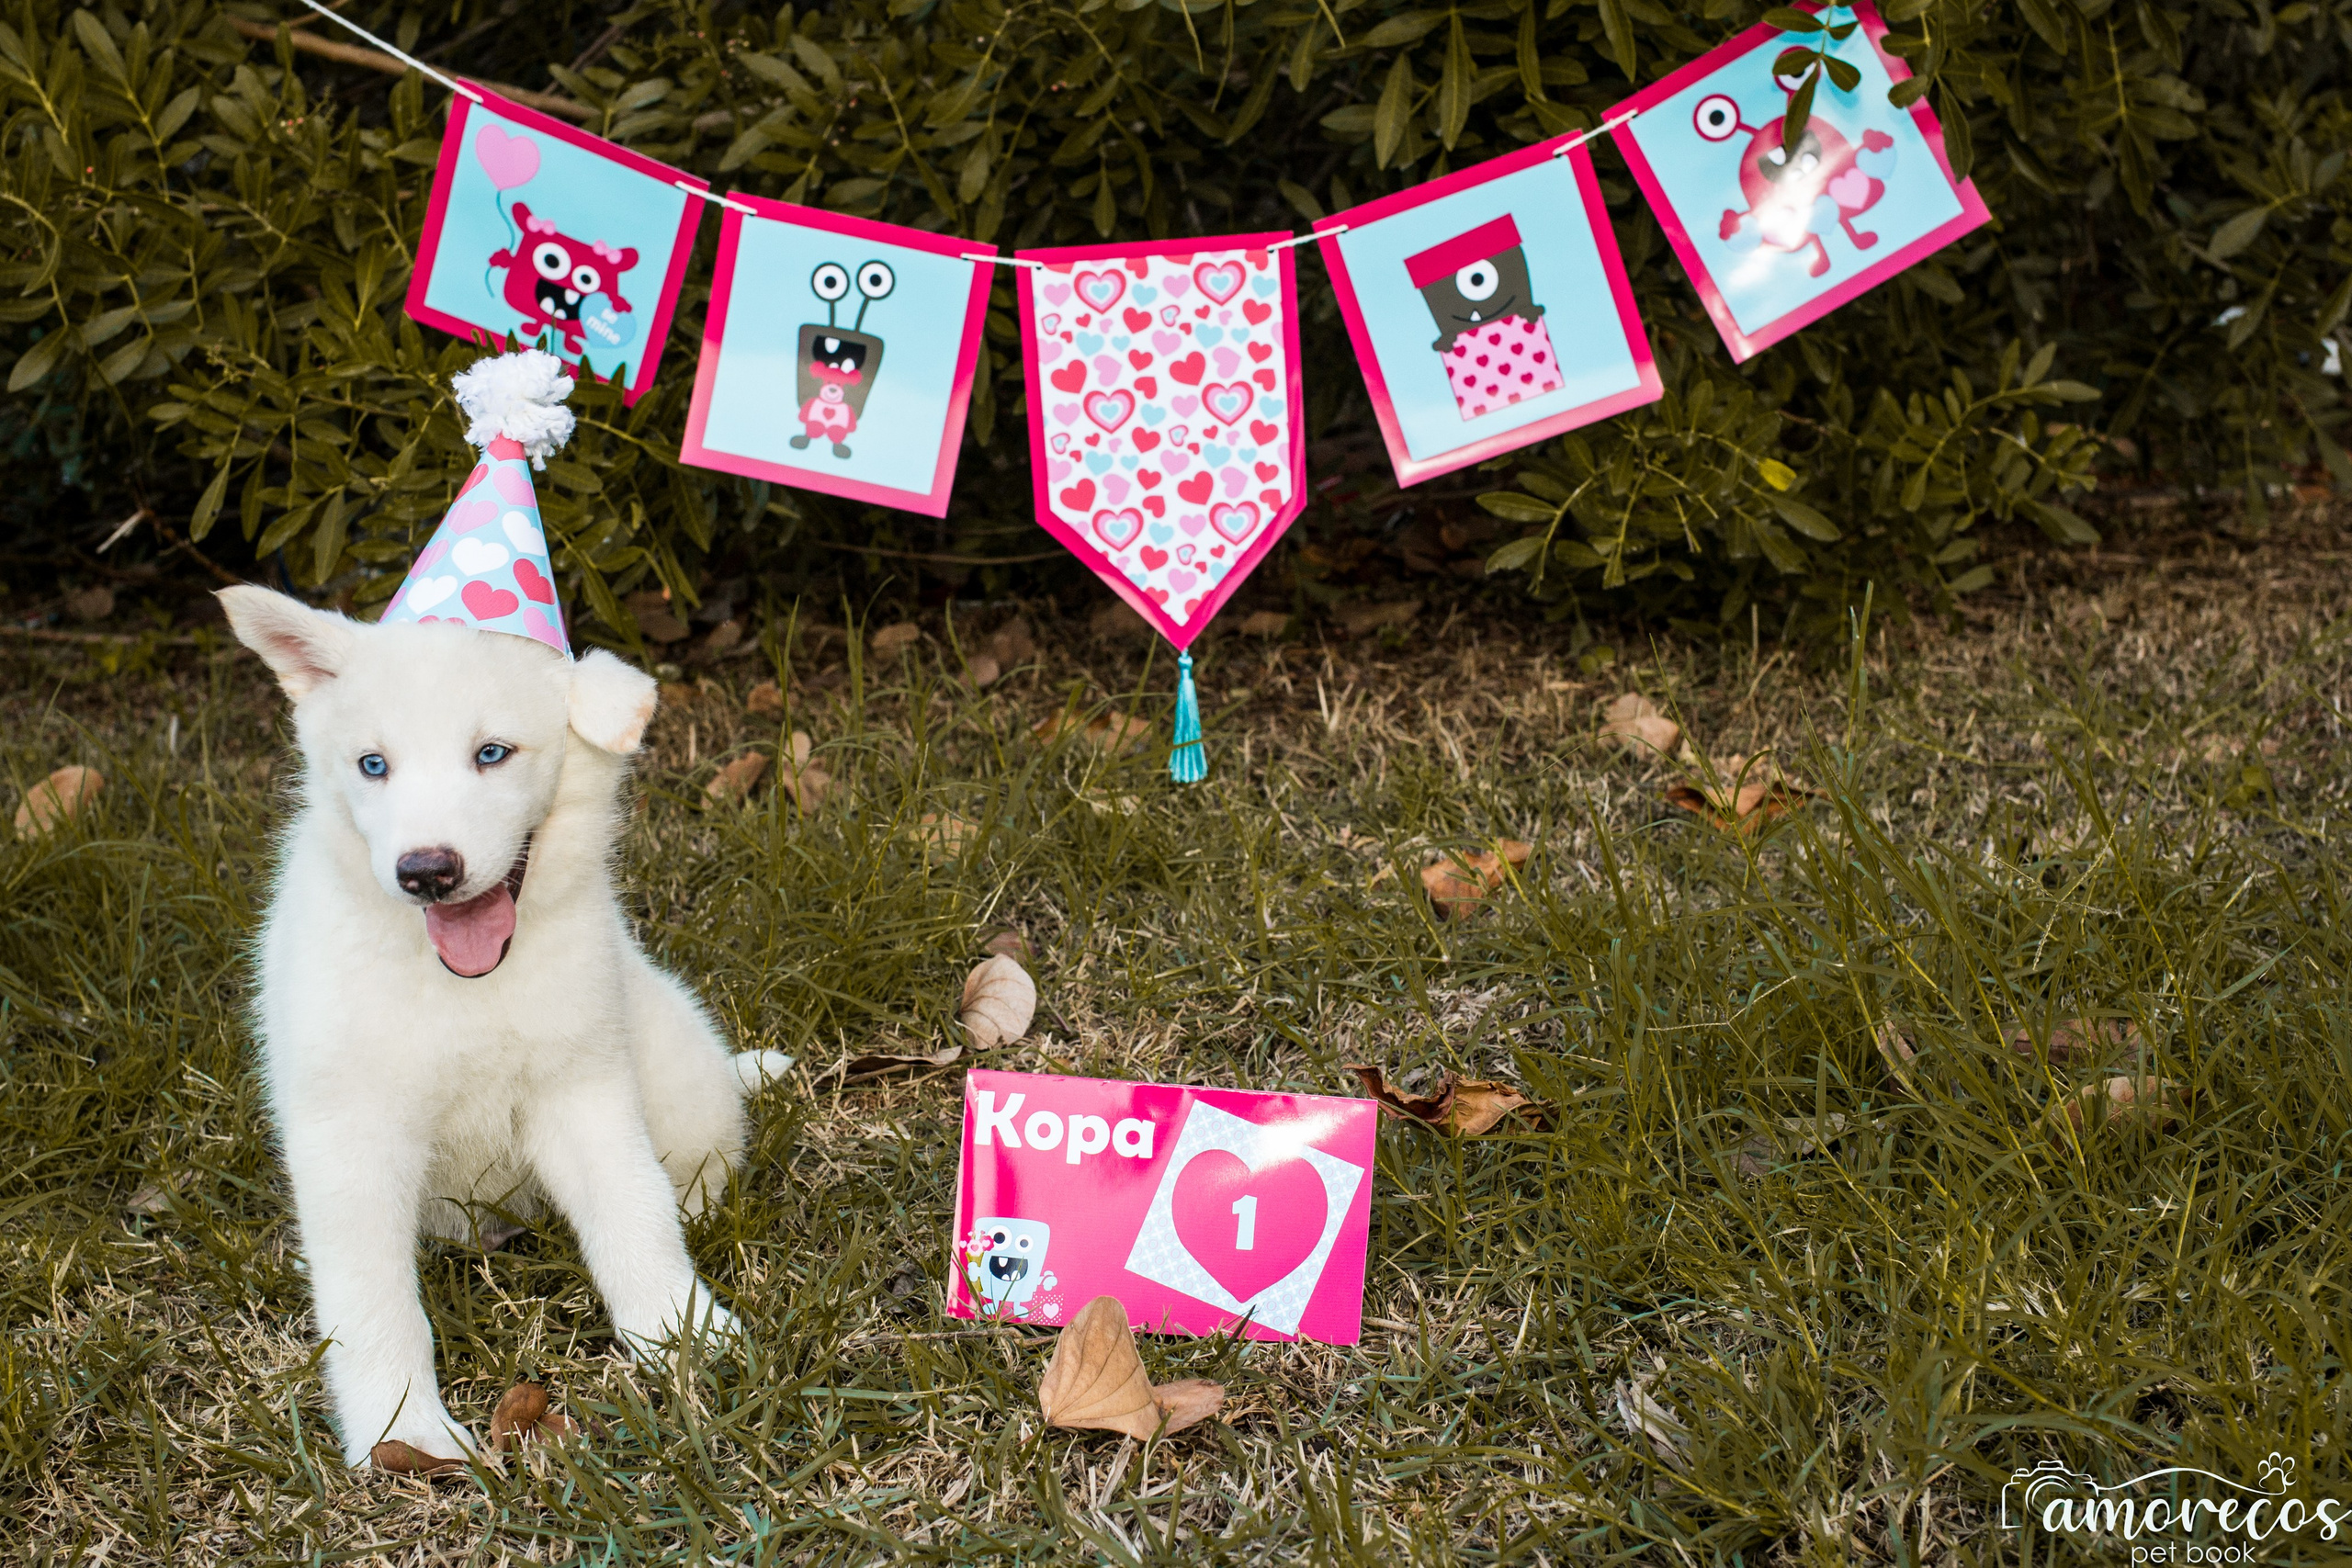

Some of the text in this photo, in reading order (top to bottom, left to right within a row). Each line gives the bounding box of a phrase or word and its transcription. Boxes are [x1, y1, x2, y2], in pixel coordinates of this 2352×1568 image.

[586, 315, 621, 345] mine
[974, 1089, 1157, 1165] Kopa
[1231, 1194, 1258, 1251] 1
